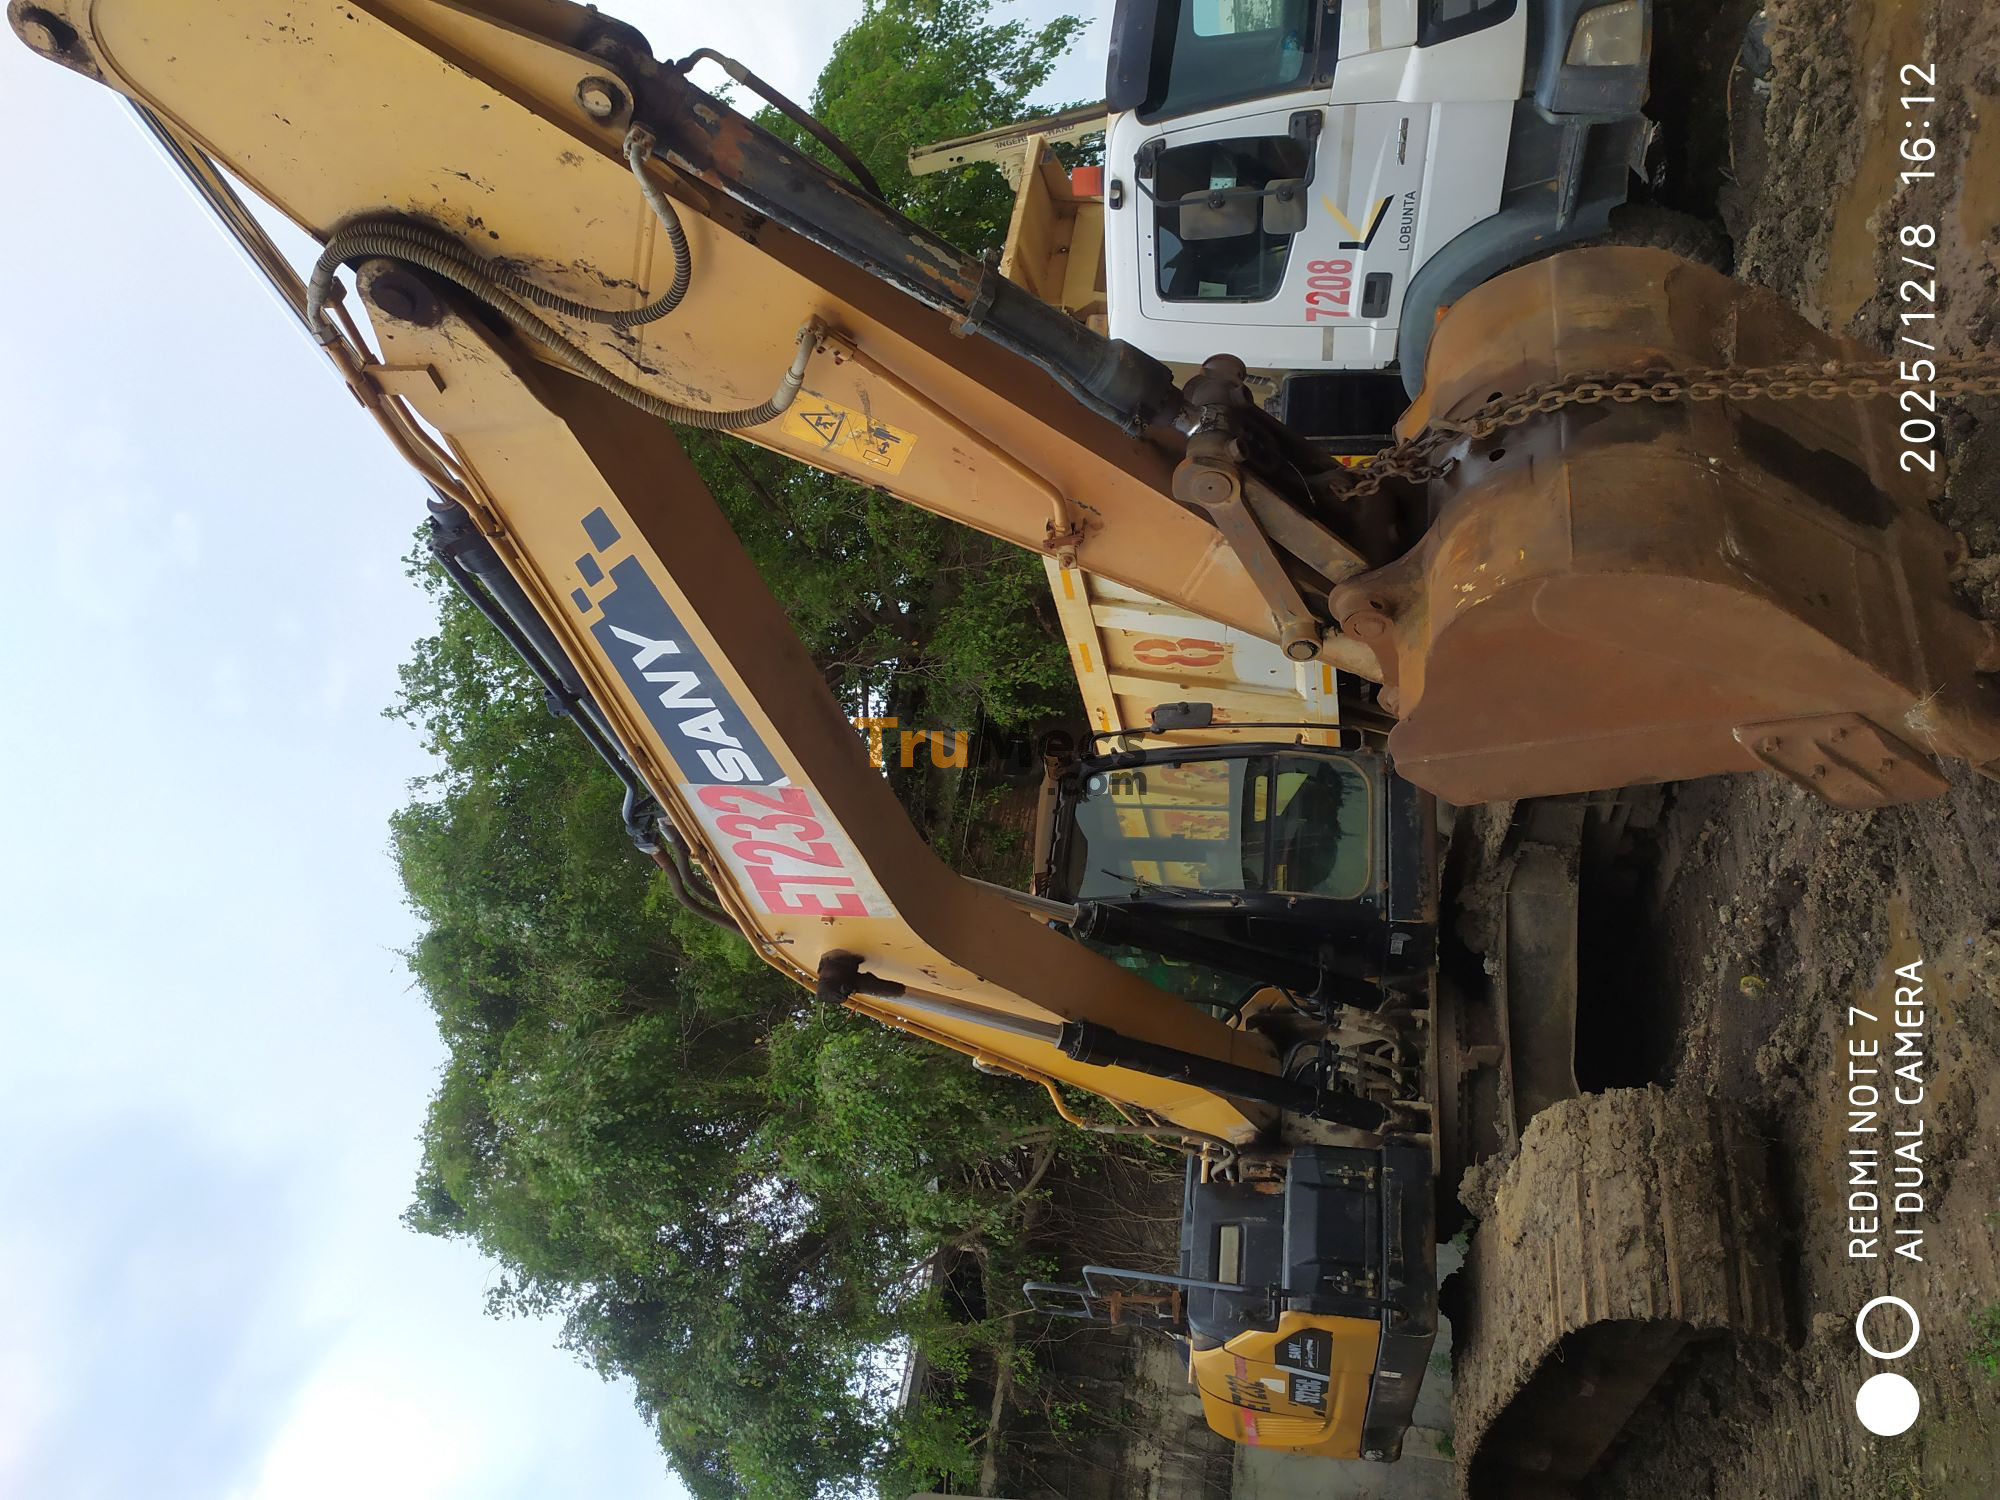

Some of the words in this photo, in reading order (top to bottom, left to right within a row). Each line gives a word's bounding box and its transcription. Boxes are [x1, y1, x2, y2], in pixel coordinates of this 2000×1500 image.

[1397, 190, 1417, 251] LOBUNTA
[1305, 259, 1353, 322] 7208
[608, 624, 764, 782] SANY
[696, 785, 869, 917] ET232
